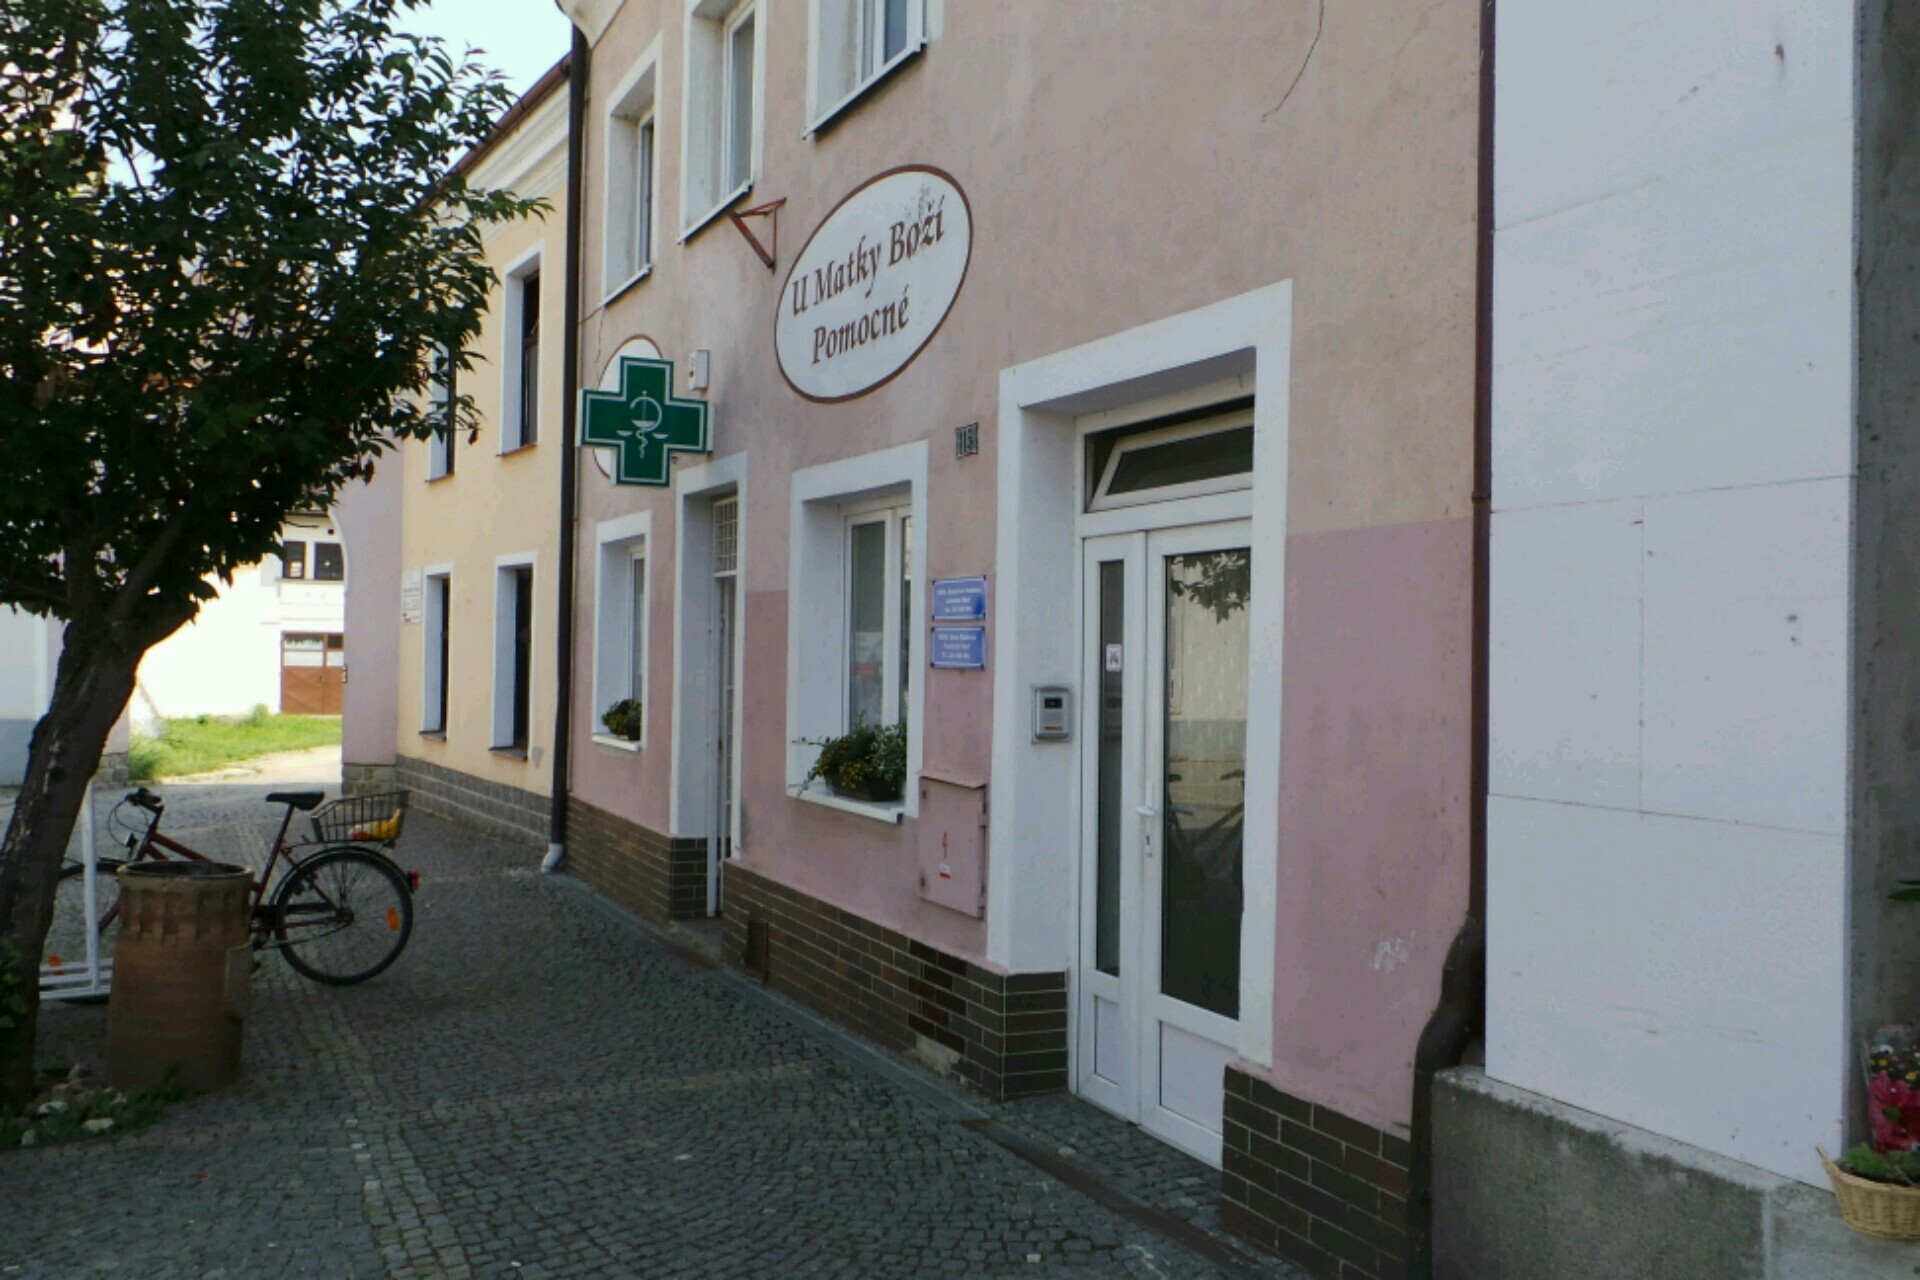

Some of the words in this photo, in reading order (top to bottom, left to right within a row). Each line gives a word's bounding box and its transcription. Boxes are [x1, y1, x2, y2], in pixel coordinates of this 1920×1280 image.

[792, 274, 809, 316] U
[813, 235, 882, 307] Matky
[888, 194, 945, 267] Boží
[811, 284, 910, 365] Pomocné
